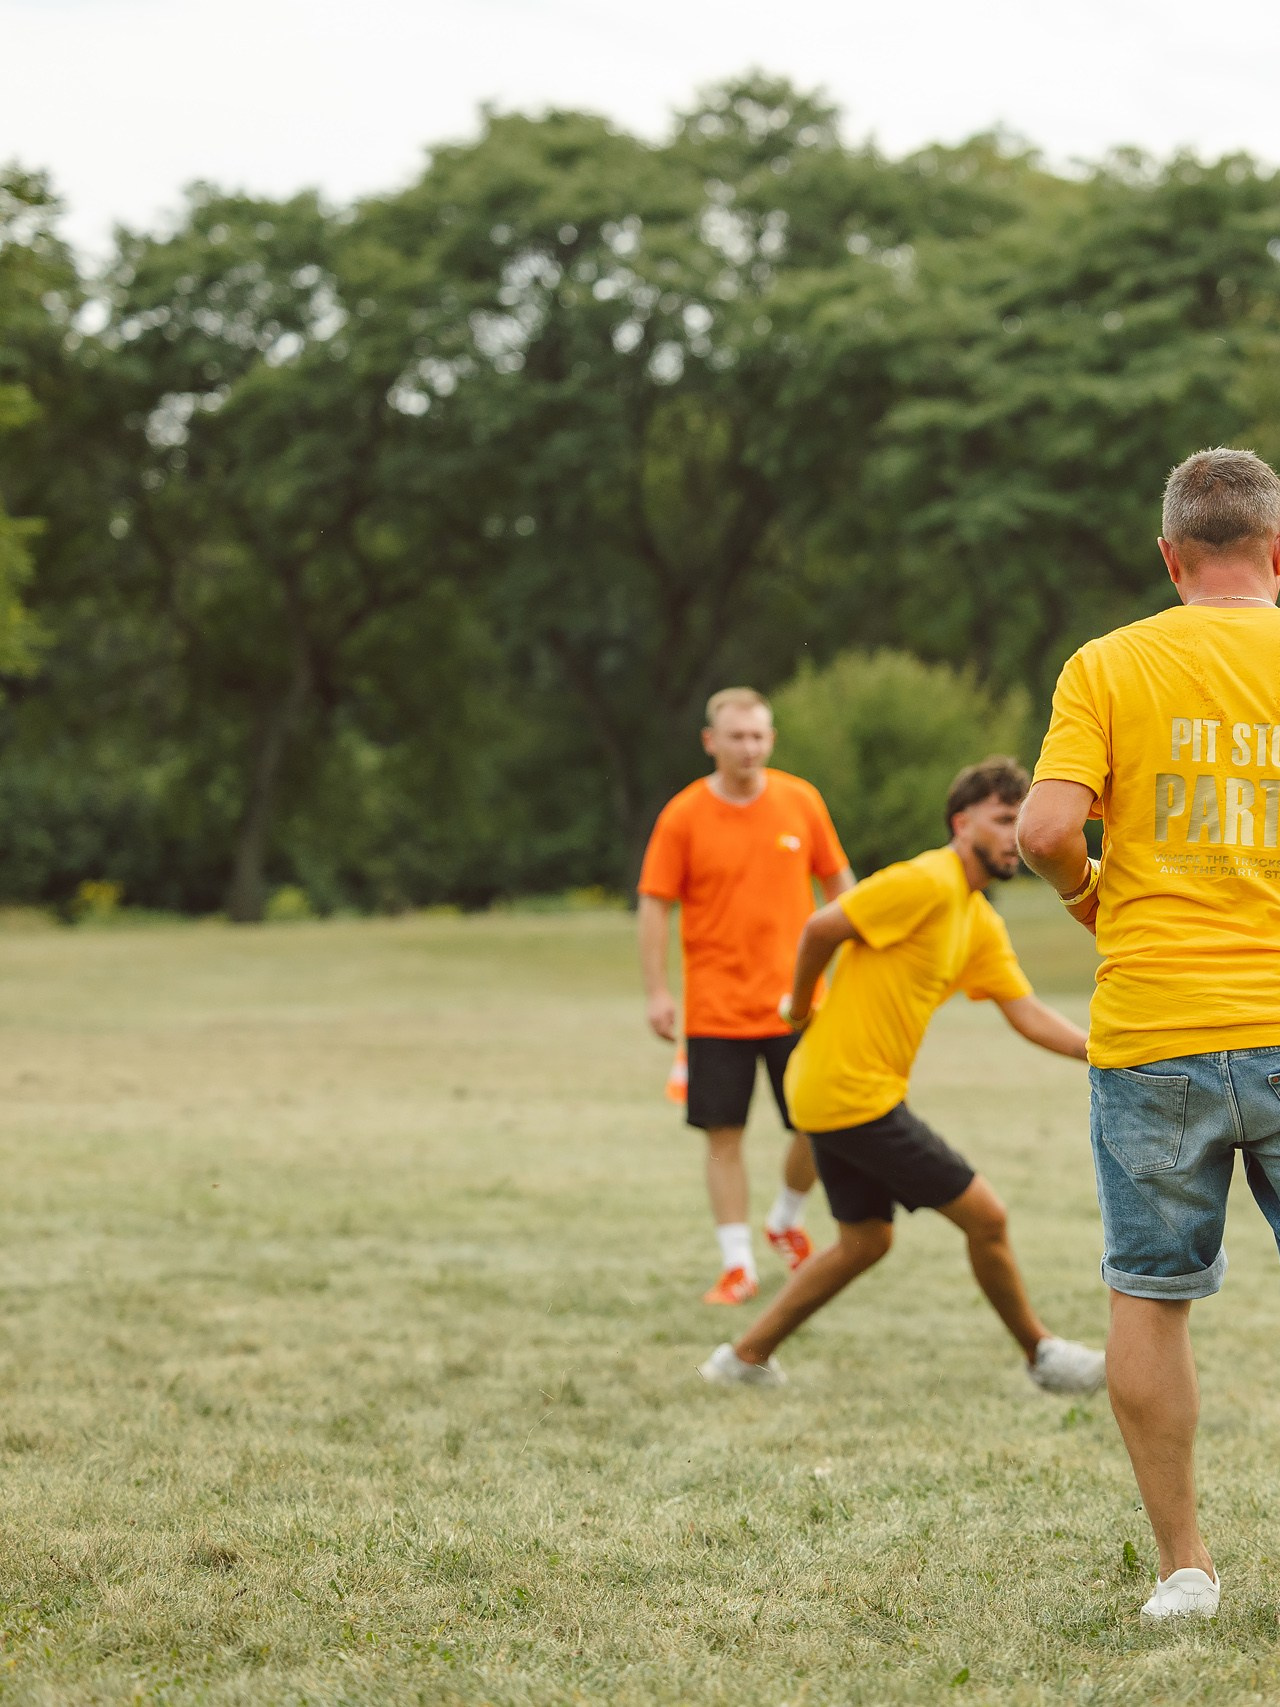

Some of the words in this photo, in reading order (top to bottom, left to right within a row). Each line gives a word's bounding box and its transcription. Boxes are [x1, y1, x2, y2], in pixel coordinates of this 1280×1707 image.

[1171, 717, 1221, 763] PIT
[1154, 853, 1201, 864] WHERE
[1207, 855, 1230, 865] THE
[1159, 865, 1189, 875] AND
[1193, 865, 1217, 876] THE
[1220, 867, 1260, 878] PARTY
